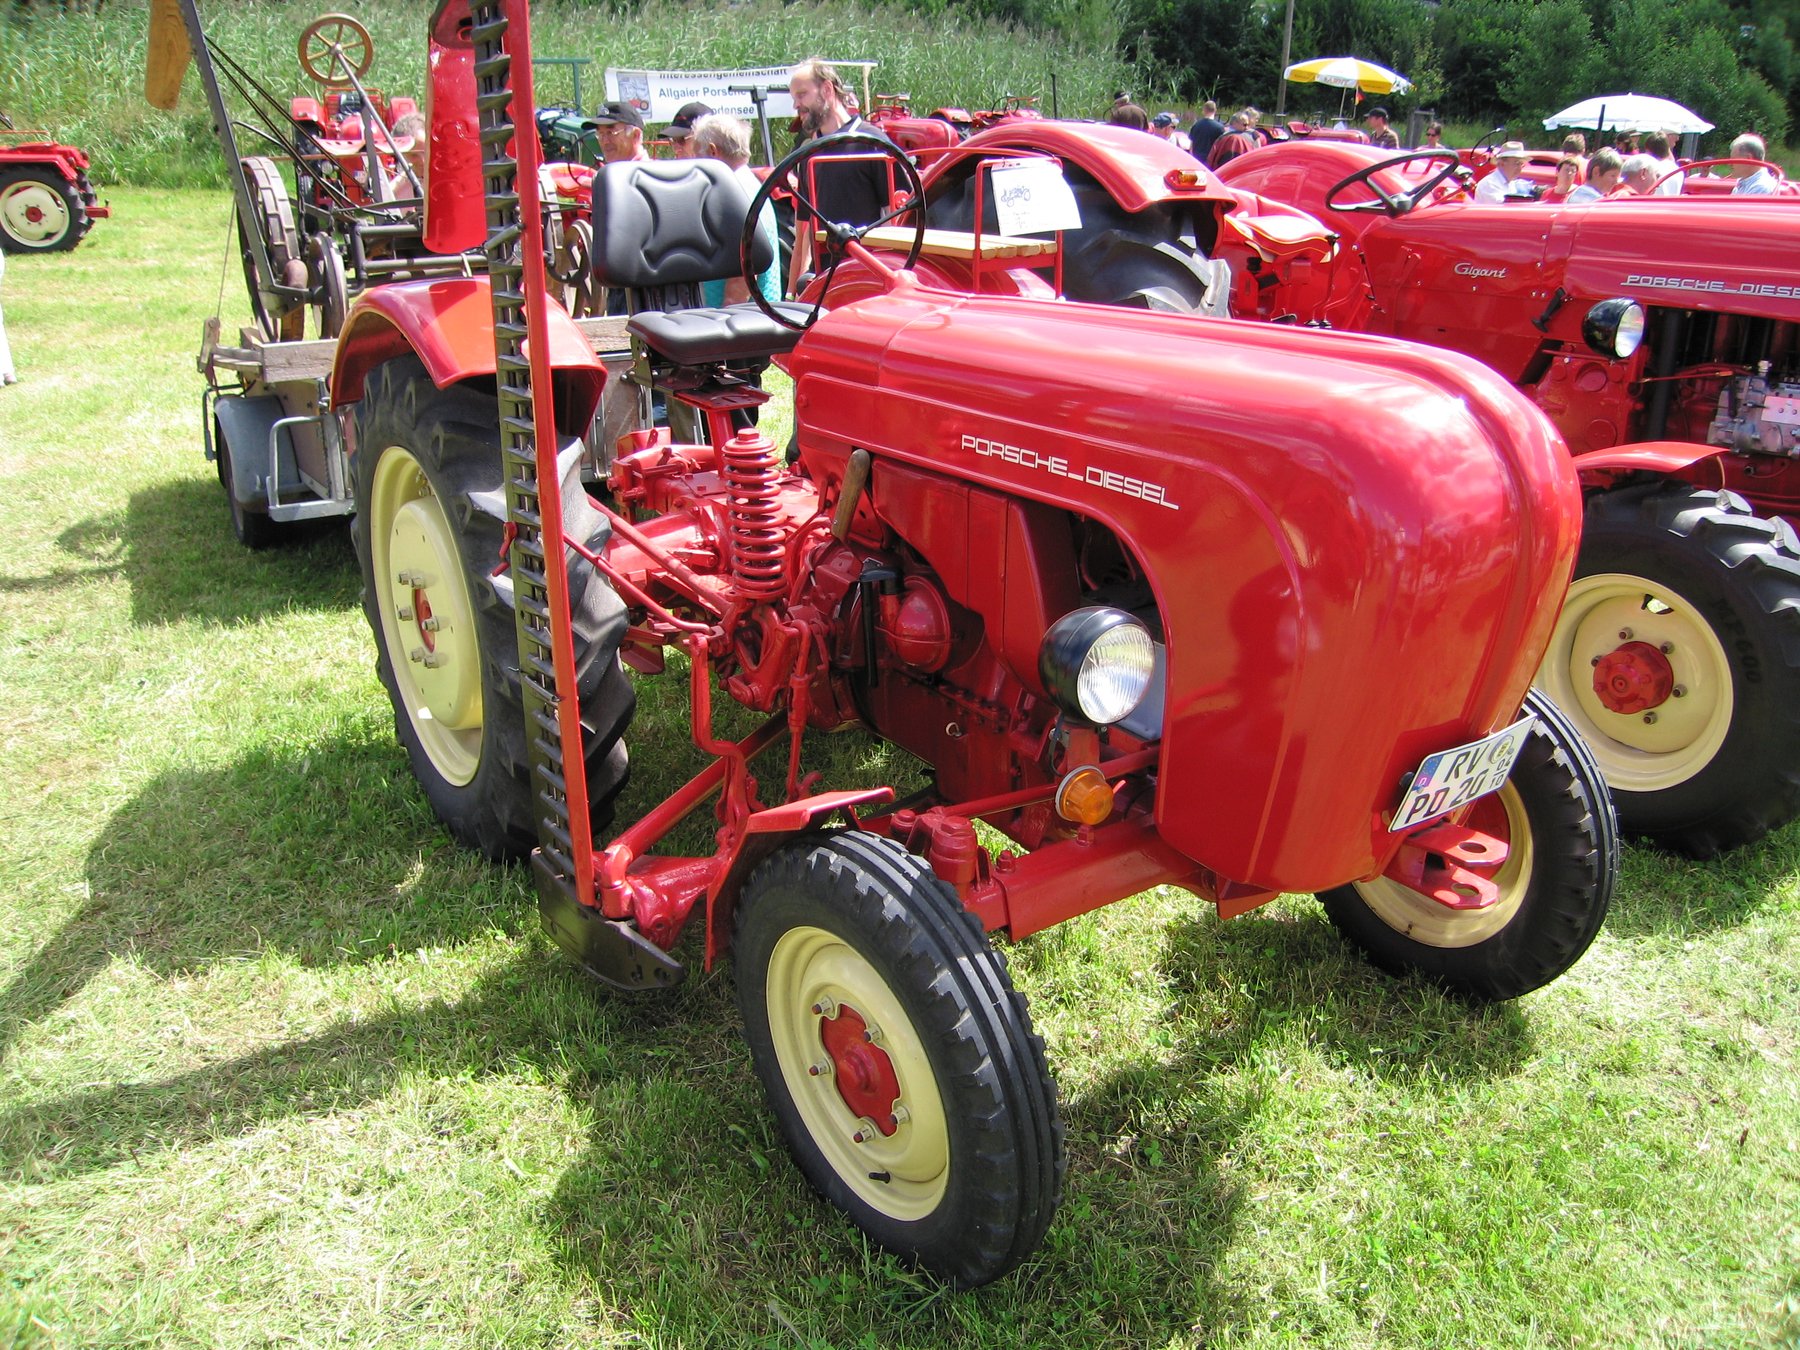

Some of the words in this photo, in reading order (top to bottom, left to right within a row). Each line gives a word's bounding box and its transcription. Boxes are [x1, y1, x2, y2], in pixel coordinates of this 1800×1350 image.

[659, 87, 699, 100] Allgaier
[712, 105, 754, 115] odensee
[1454, 262, 1506, 278] Gigant
[1444, 743, 1490, 783] RV
[1405, 787, 1450, 824] PD
[1449, 768, 1489, 806] 20
